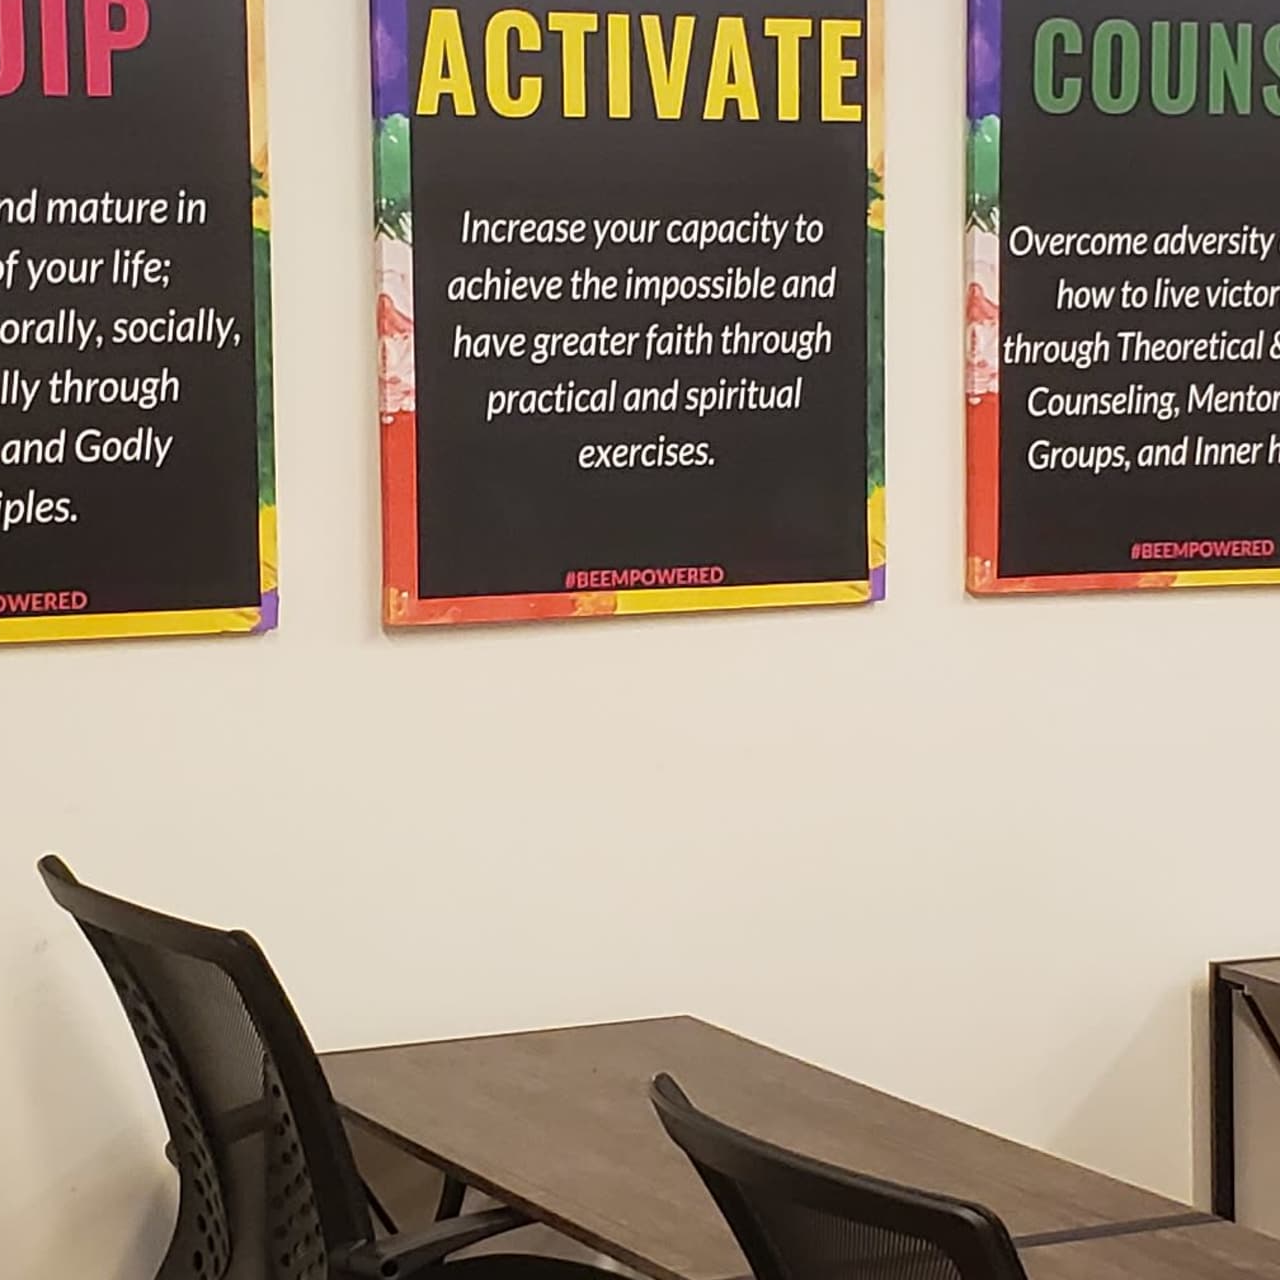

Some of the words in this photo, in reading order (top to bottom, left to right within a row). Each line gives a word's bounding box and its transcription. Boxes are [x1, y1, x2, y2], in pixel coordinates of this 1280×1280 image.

[416, 9, 861, 121] ACTIVATE
[47, 192, 167, 223] mature
[178, 190, 205, 223] in
[462, 211, 586, 243] Increase
[594, 220, 660, 249] your
[667, 212, 789, 249] capacity
[795, 214, 823, 242] to
[1010, 226, 1147, 255] Overcome
[1154, 225, 1275, 260] adversity
[27, 259, 104, 290] your
[113, 249, 170, 288] life;
[448, 268, 562, 300] achieve
[571, 268, 617, 299] the
[626, 267, 776, 306] impossible
[783, 267, 836, 298] and
[1057, 279, 1115, 309] how
[1121, 281, 1147, 308] to
[1155, 278, 1200, 307] live
[112, 308, 240, 348] socially,
[454, 325, 525, 357] have
[531, 327, 640, 363] greater
[646, 323, 712, 360] faith
[721, 322, 831, 360] through
[1004, 332, 1109, 368] through
[1117, 330, 1264, 361] Theoretical
[49, 368, 179, 409] through
[487, 380, 616, 421] practical
[624, 379, 678, 411] and
[685, 377, 802, 416] spiritual
[1028, 384, 1179, 420] Counseling,
[1, 429, 65, 464] and
[75, 427, 173, 467] Godly
[579, 435, 714, 468] exercises.
[1028, 440, 1130, 474] Groups,
[1138, 436, 1188, 466] and
[1195, 437, 1263, 465] Inner
[1132, 540, 1274, 559] #BEEMPOWERED
[566, 567, 724, 588] #BEEMPOWERED
